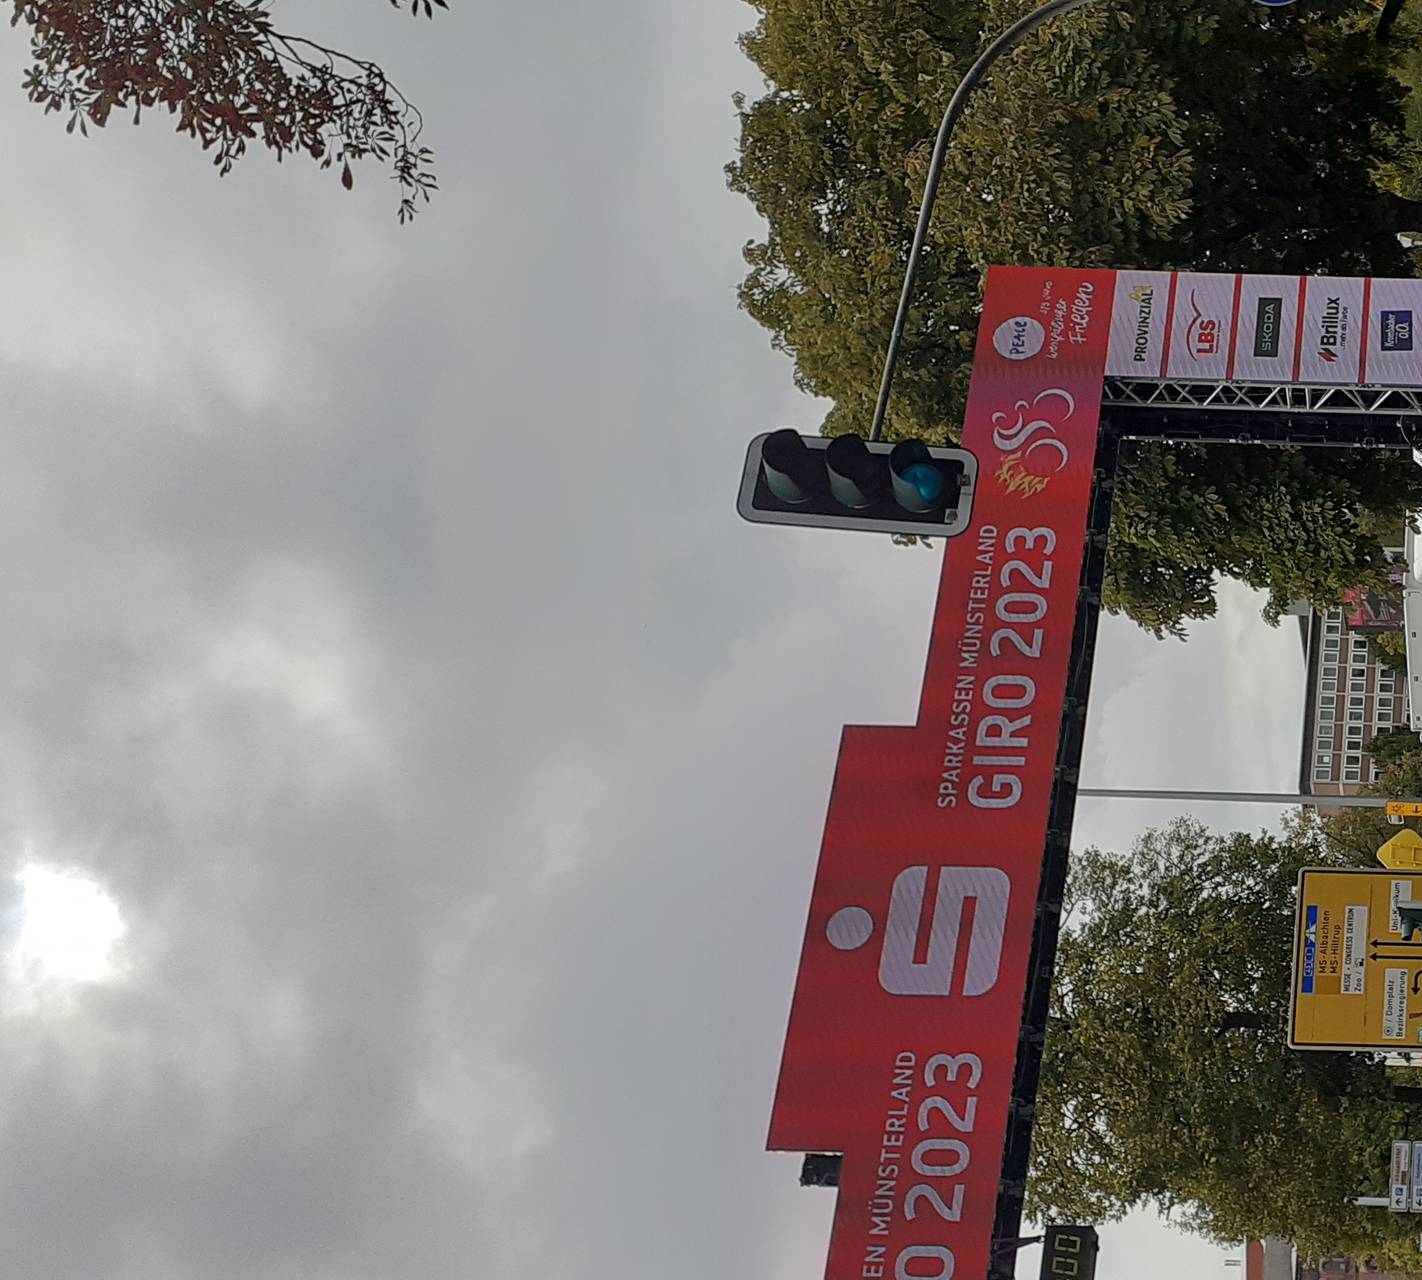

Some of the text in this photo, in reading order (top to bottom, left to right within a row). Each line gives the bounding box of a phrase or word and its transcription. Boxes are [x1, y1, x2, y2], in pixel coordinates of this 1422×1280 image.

[1068, 282, 1094, 344] Frieden
[1133, 289, 1154, 362] PROVINZIAL
[1196, 320, 1216, 354] LBS
[1319, 297, 1340, 346] Brillux
[1384, 313, 1396, 347] Krombacher
[937, 524, 998, 808] SPARKASSEN MÜNSTERLAND
[967, 527, 1057, 808] GIRO 2023
[1319, 910, 1330, 974] MS-Albachten
[1346, 908, 1354, 934] CENTRUM
[1330, 924, 1341, 974] MS-Hiltrup
[1344, 936, 1353, 965] CONGRESS
[1343, 974, 1351, 992] MESSE
[1354, 978, 1362, 992] Zoo
[1385, 979, 1395, 1016] Domplatz
[1396, 971, 1408, 1038] Bezirksregierung
[868, 1051, 916, 1235] MÜNSTERLAND
[904, 1052, 982, 1221] 2023
